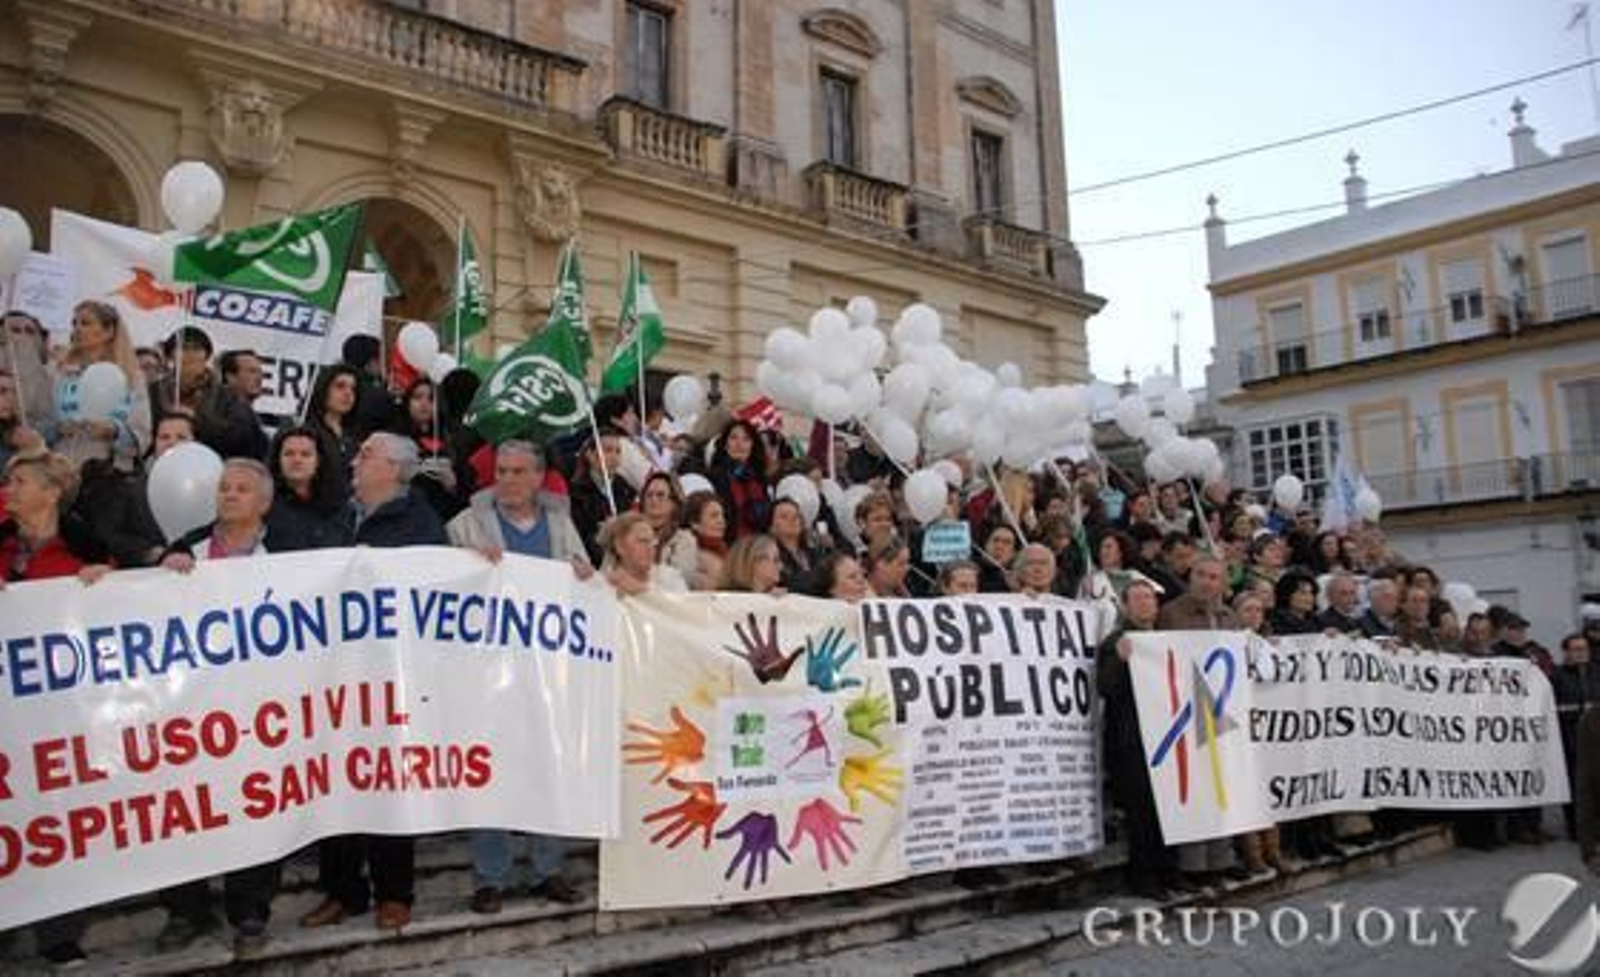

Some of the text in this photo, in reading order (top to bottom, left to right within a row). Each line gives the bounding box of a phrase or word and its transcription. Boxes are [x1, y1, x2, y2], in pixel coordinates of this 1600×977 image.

[0, 587, 328, 697] EDERACIÓN
[340, 587, 397, 642] DE
[861, 603, 1096, 659] HOSPITAL
[889, 663, 1092, 724] PÚBLICO
[33, 735, 108, 792] EL
[241, 753, 329, 819] SAN
[345, 744, 492, 792] CARLOS
